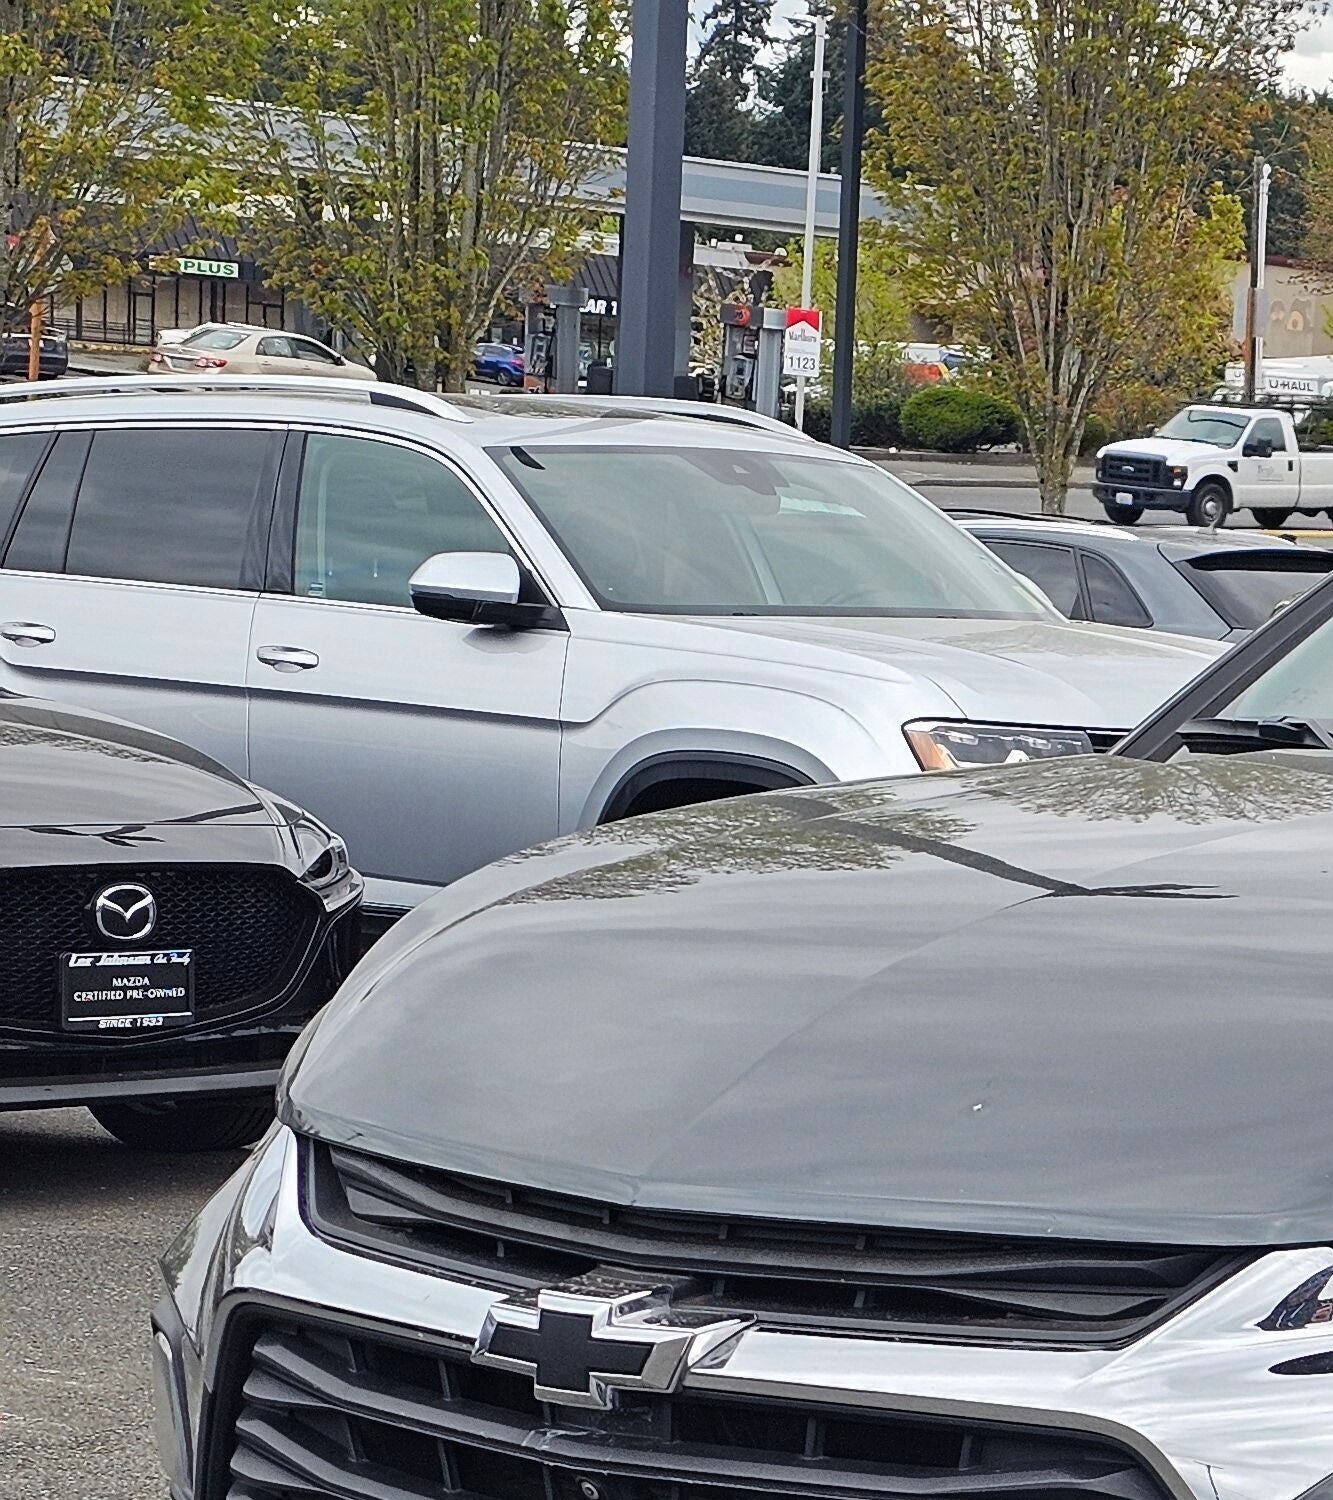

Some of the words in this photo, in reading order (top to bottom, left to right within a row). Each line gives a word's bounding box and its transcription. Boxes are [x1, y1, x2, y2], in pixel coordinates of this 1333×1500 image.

[183, 260, 235, 276] PLUS
[1268, 379, 1314, 392] U-HAUL
[112, 976, 151, 988] MAZDA
[73, 990, 124, 1002] CERTIFIED
[126, 986, 186, 1000] PRE-OWNED
[98, 1018, 133, 1029] SINCE
